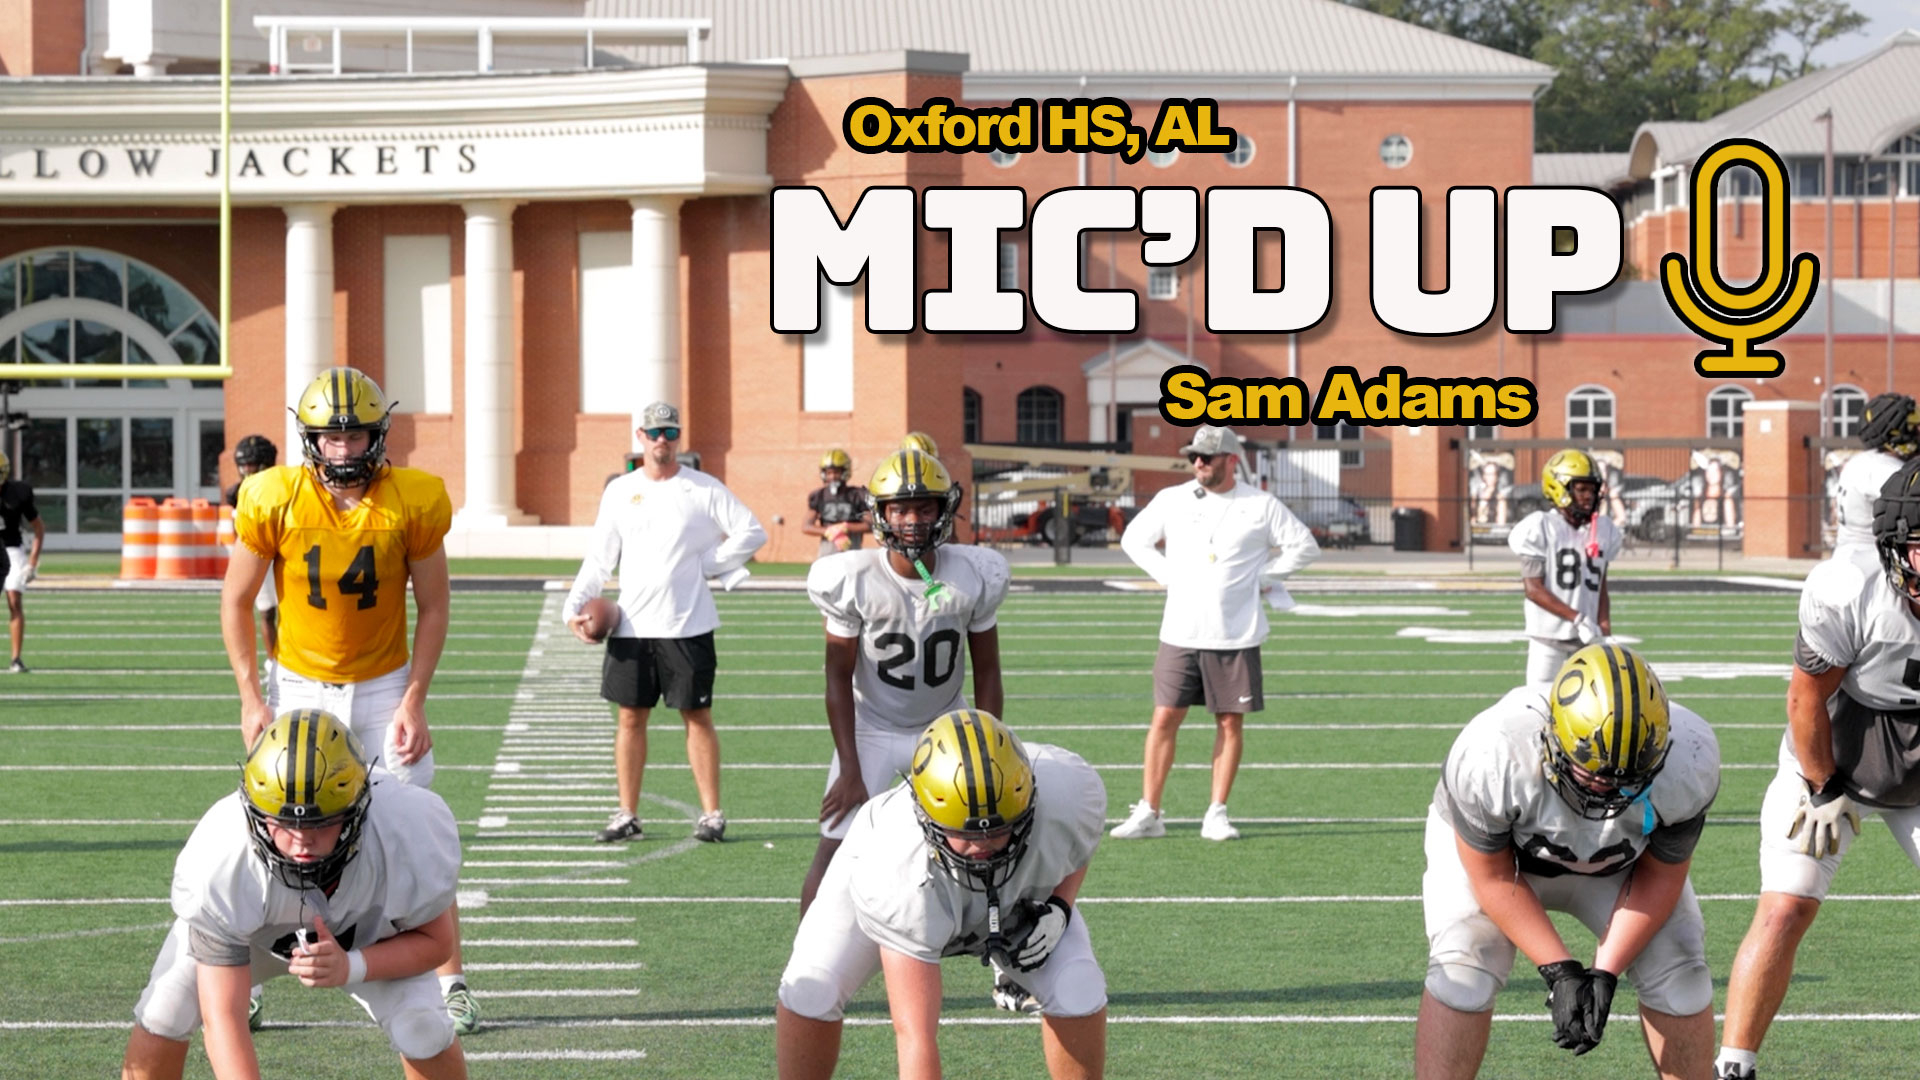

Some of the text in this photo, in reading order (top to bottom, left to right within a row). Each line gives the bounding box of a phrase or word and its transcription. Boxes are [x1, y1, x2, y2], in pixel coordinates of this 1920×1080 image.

[205, 144, 477, 178] JACKETS
[303, 544, 380, 611] 14
[1556, 547, 1604, 592] 85
[874, 628, 961, 690] 20
